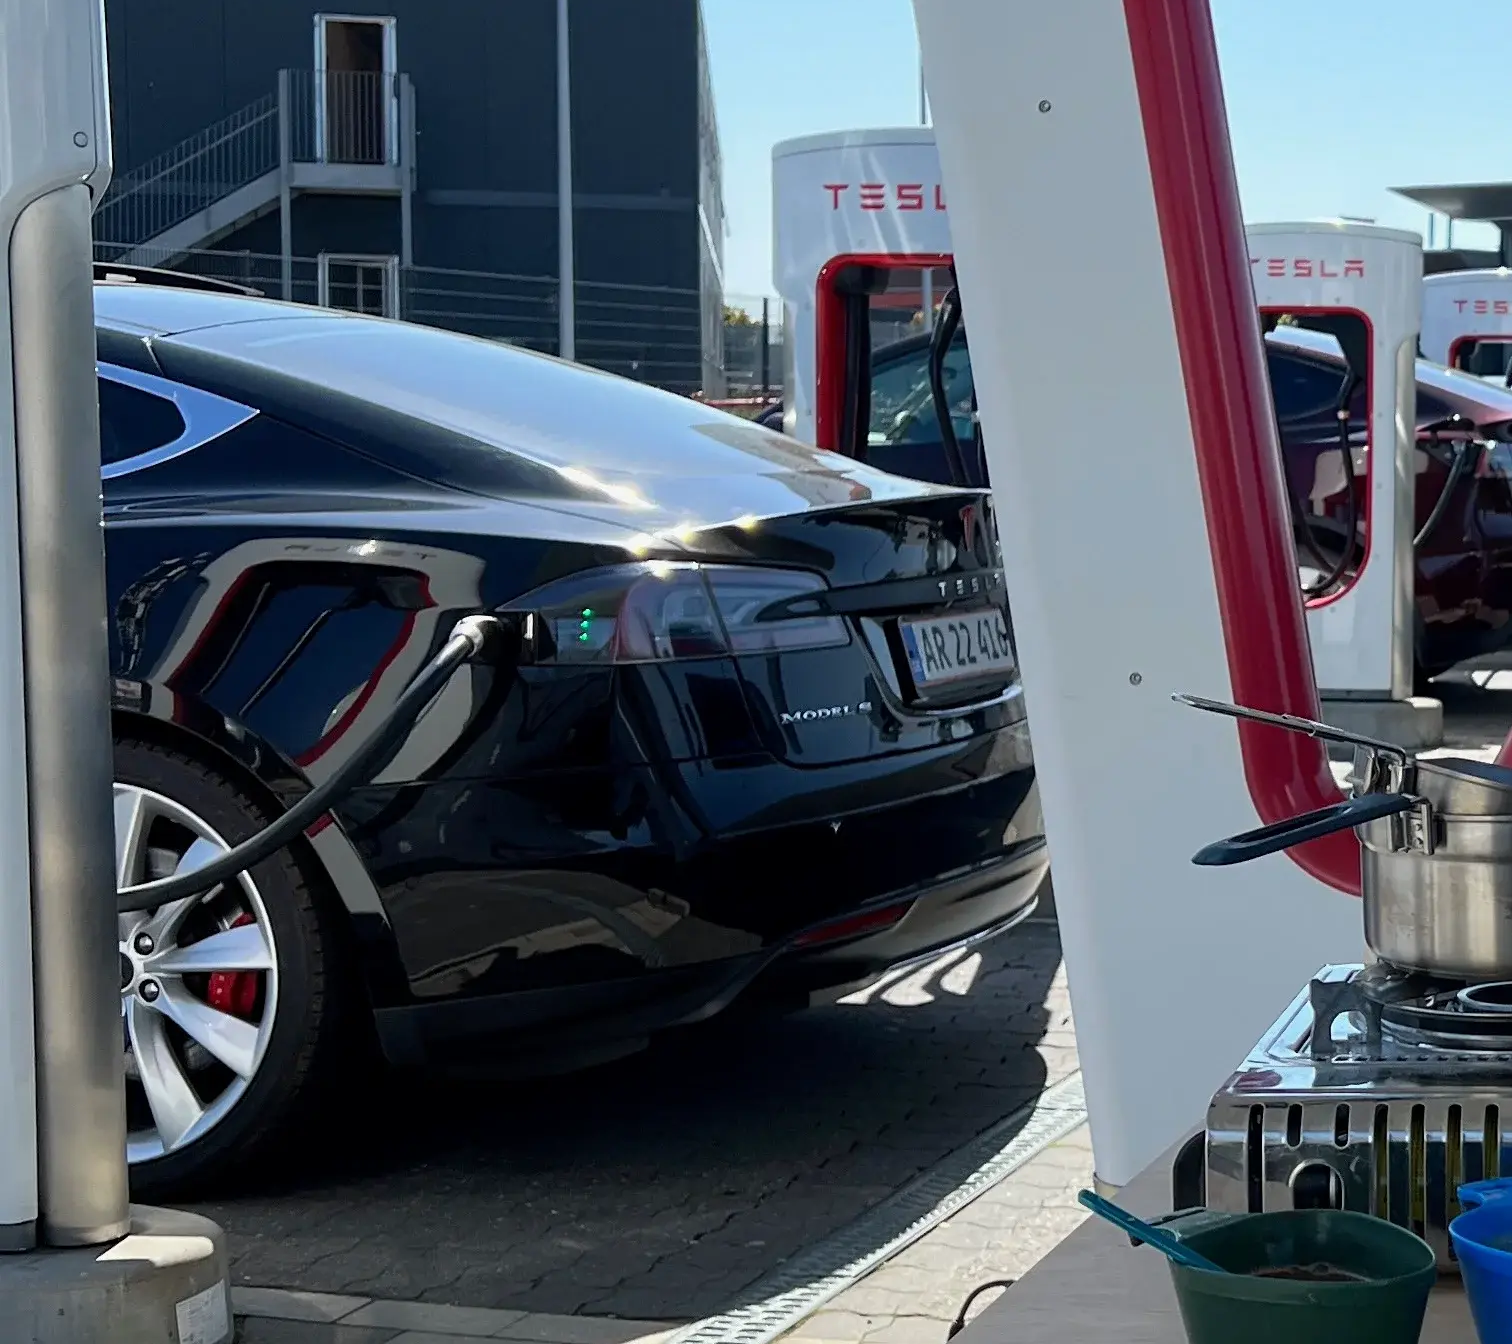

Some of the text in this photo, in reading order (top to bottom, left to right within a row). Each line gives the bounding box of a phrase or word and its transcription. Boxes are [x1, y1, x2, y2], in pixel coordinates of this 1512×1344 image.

[823, 183, 947, 210] TESL
[1250, 258, 1365, 278] ESLA
[920, 624, 953, 672] AR
[948, 620, 977, 667] 22
